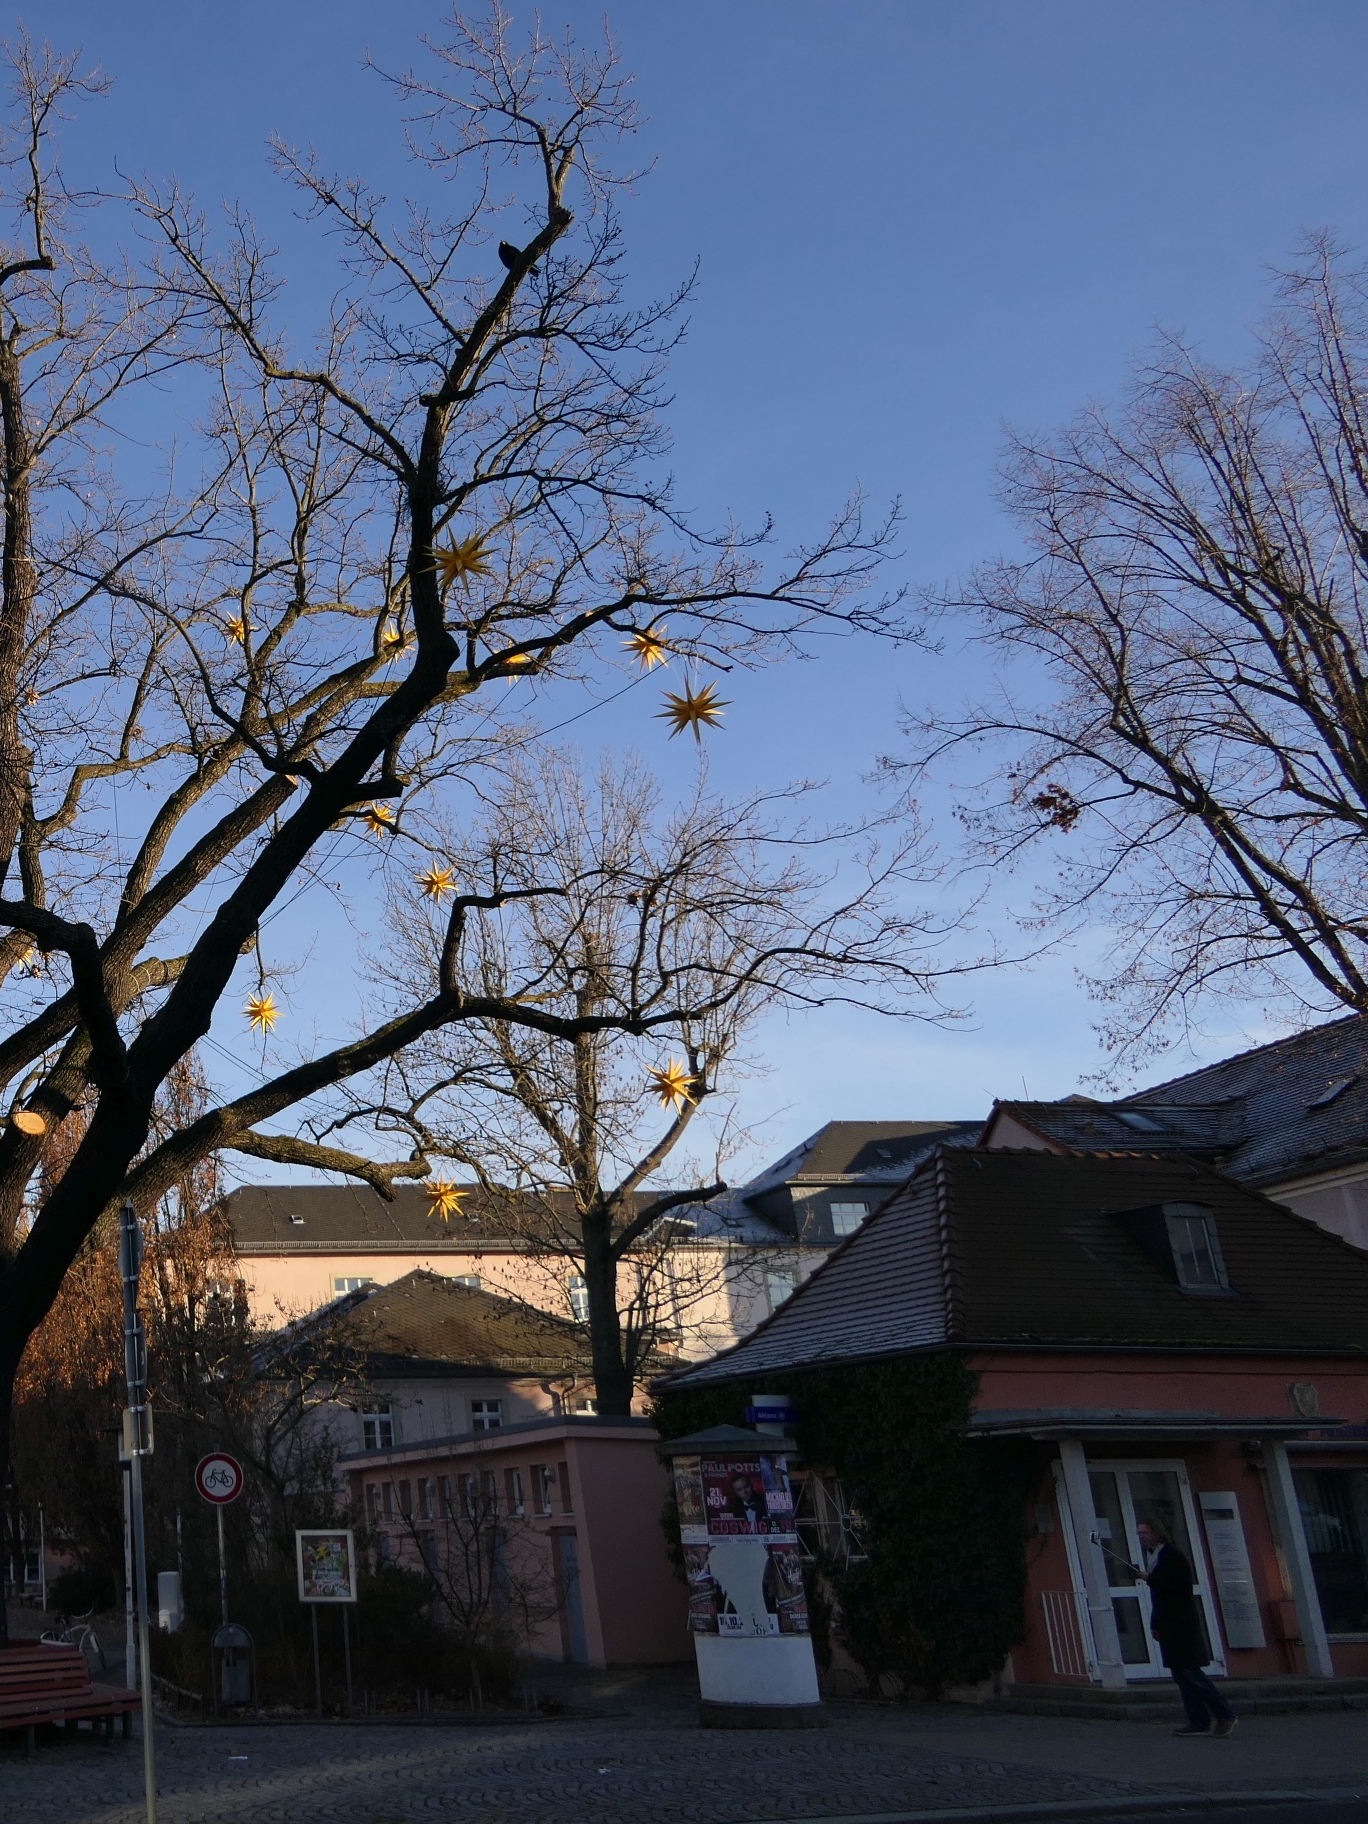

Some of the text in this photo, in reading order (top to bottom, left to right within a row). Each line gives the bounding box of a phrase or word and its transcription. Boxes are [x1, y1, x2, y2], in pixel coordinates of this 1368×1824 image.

[702, 1463, 761, 1473] PAUL POTTS
[709, 1487, 723, 1497] 21.
[706, 1496, 727, 1506] NOV
[711, 1520, 768, 1534] COSWIG
